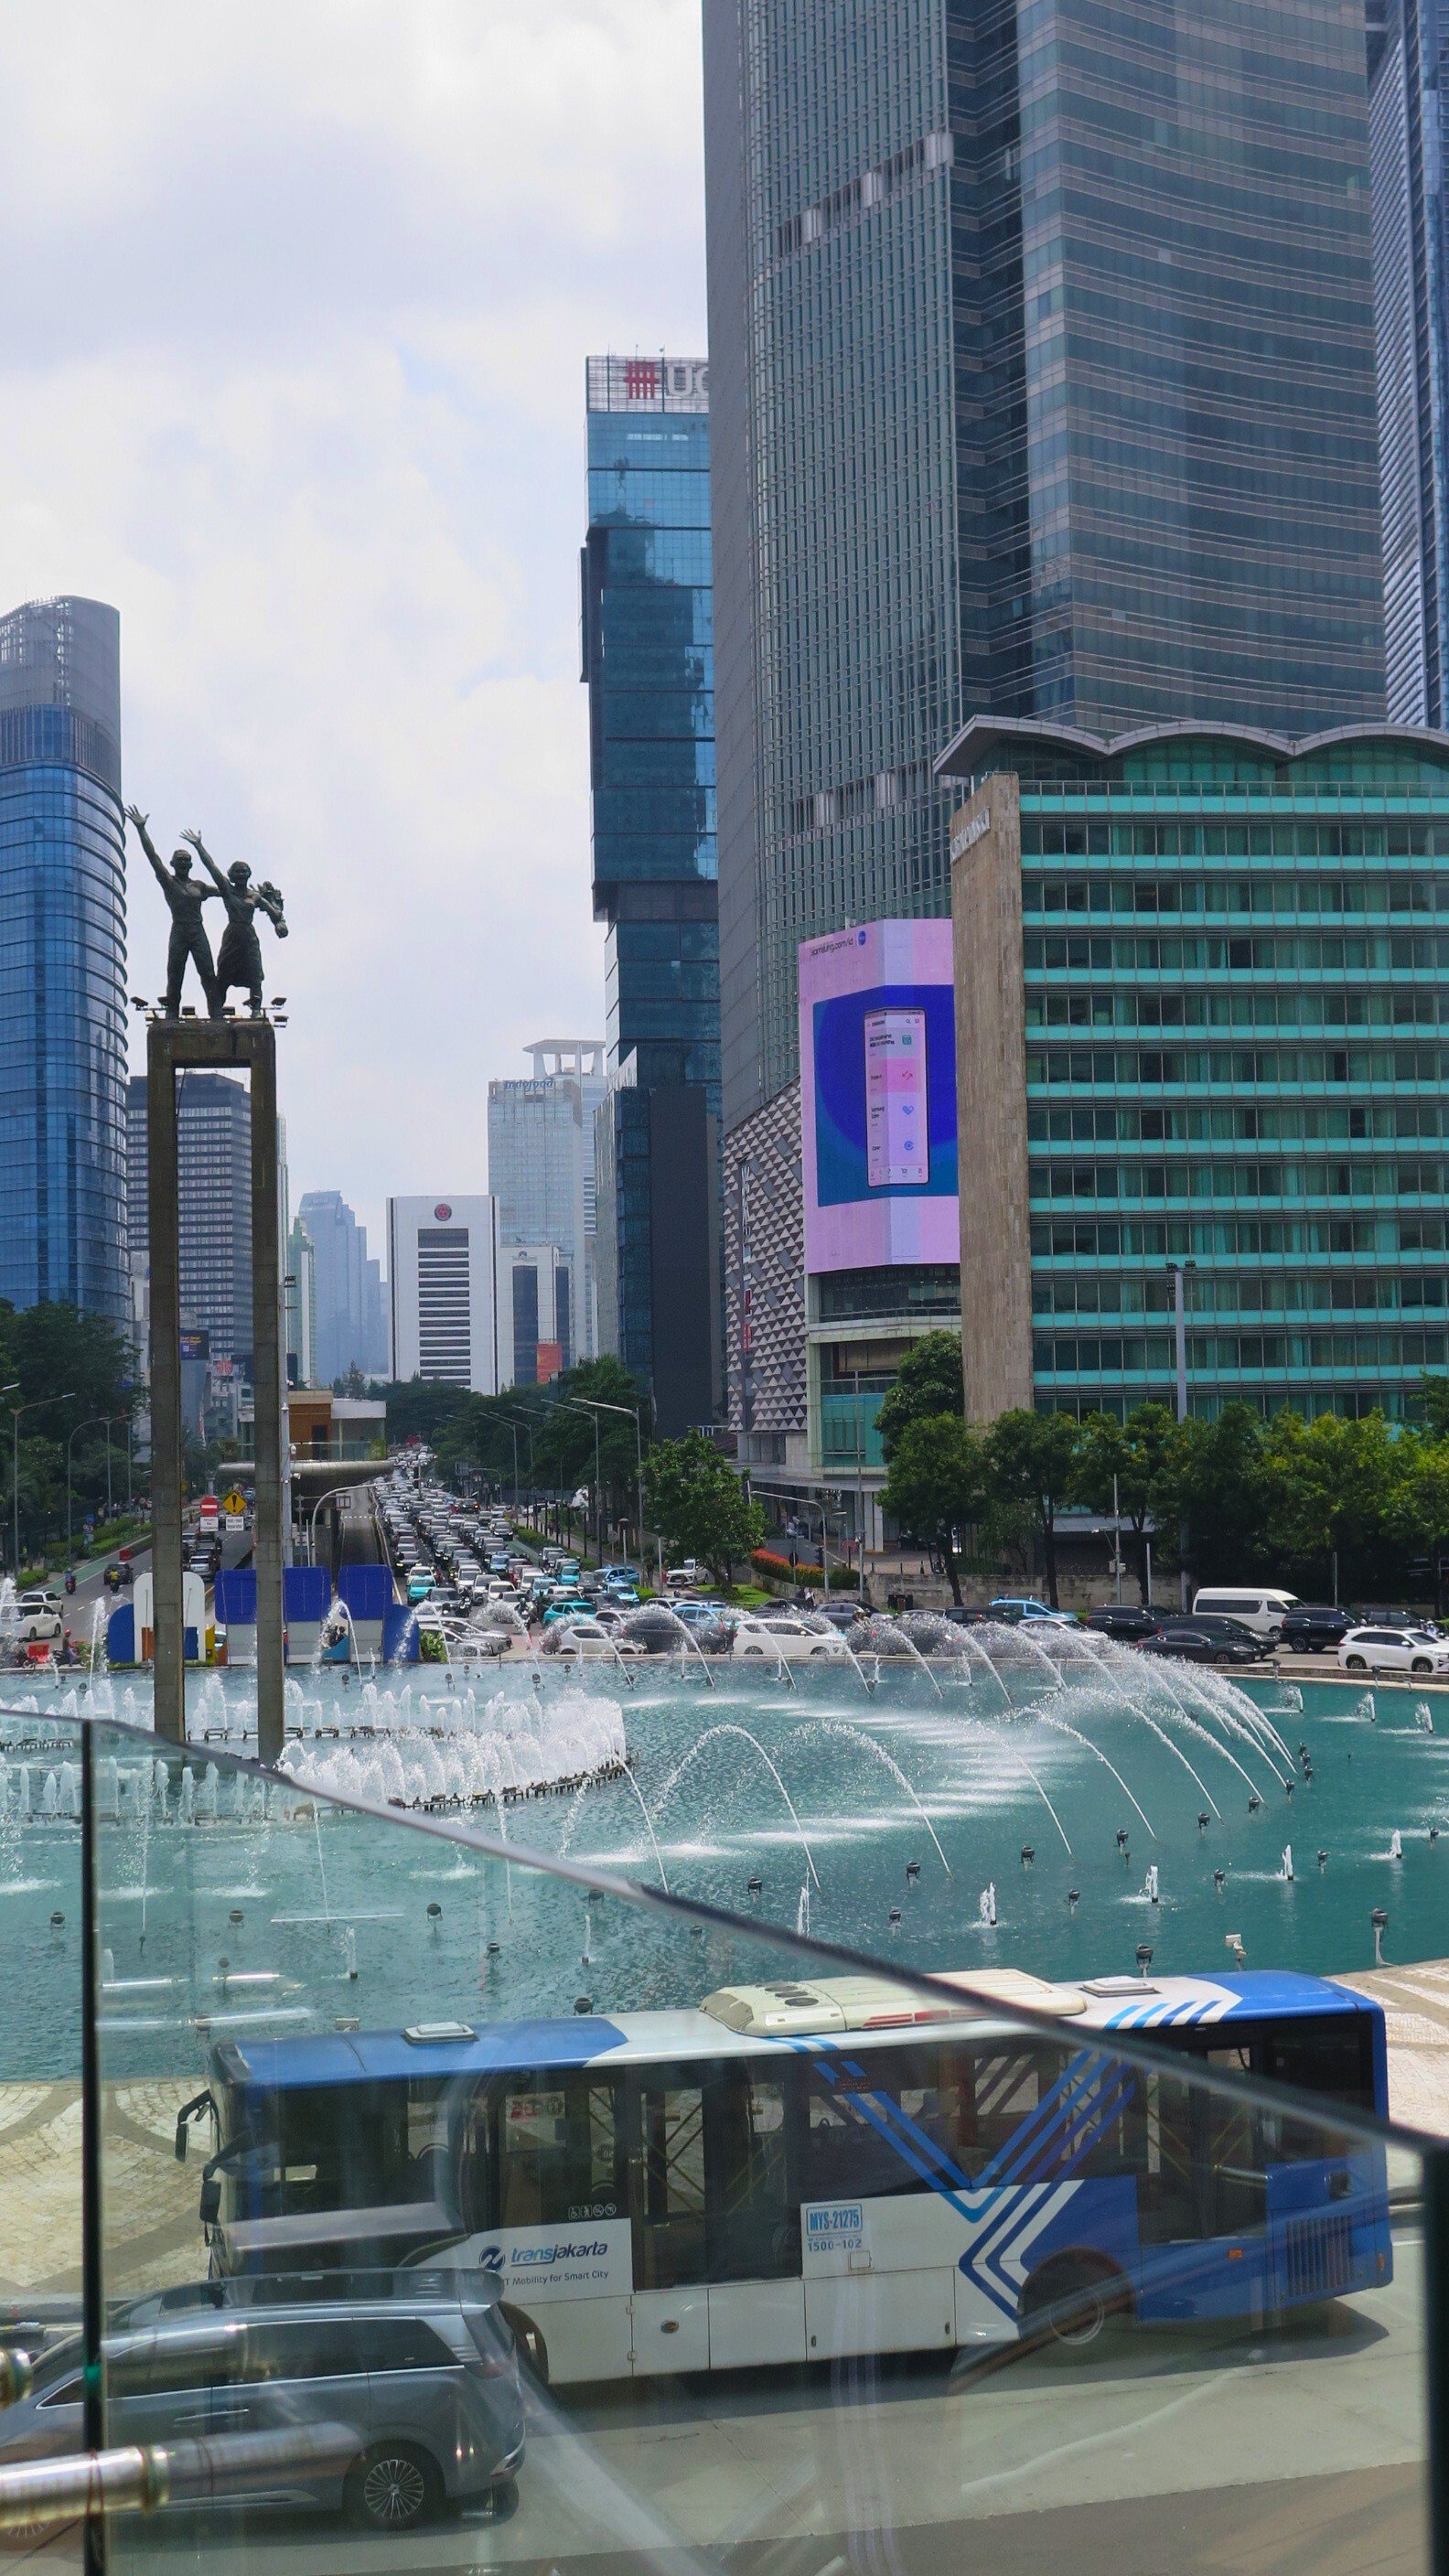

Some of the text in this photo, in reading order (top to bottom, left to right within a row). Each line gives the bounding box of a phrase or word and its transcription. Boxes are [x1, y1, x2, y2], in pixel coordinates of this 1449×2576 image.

[810, 2209, 859, 2231] MYS-21275
[510, 2241, 607, 2267] transjakarta
[808, 2238, 862, 2251] 1500-102
[513, 2274, 548, 2286] Mobility
[550, 2274, 562, 2282] for
[564, 2272, 589, 2281] Smart
[592, 2270, 608, 2279] City
